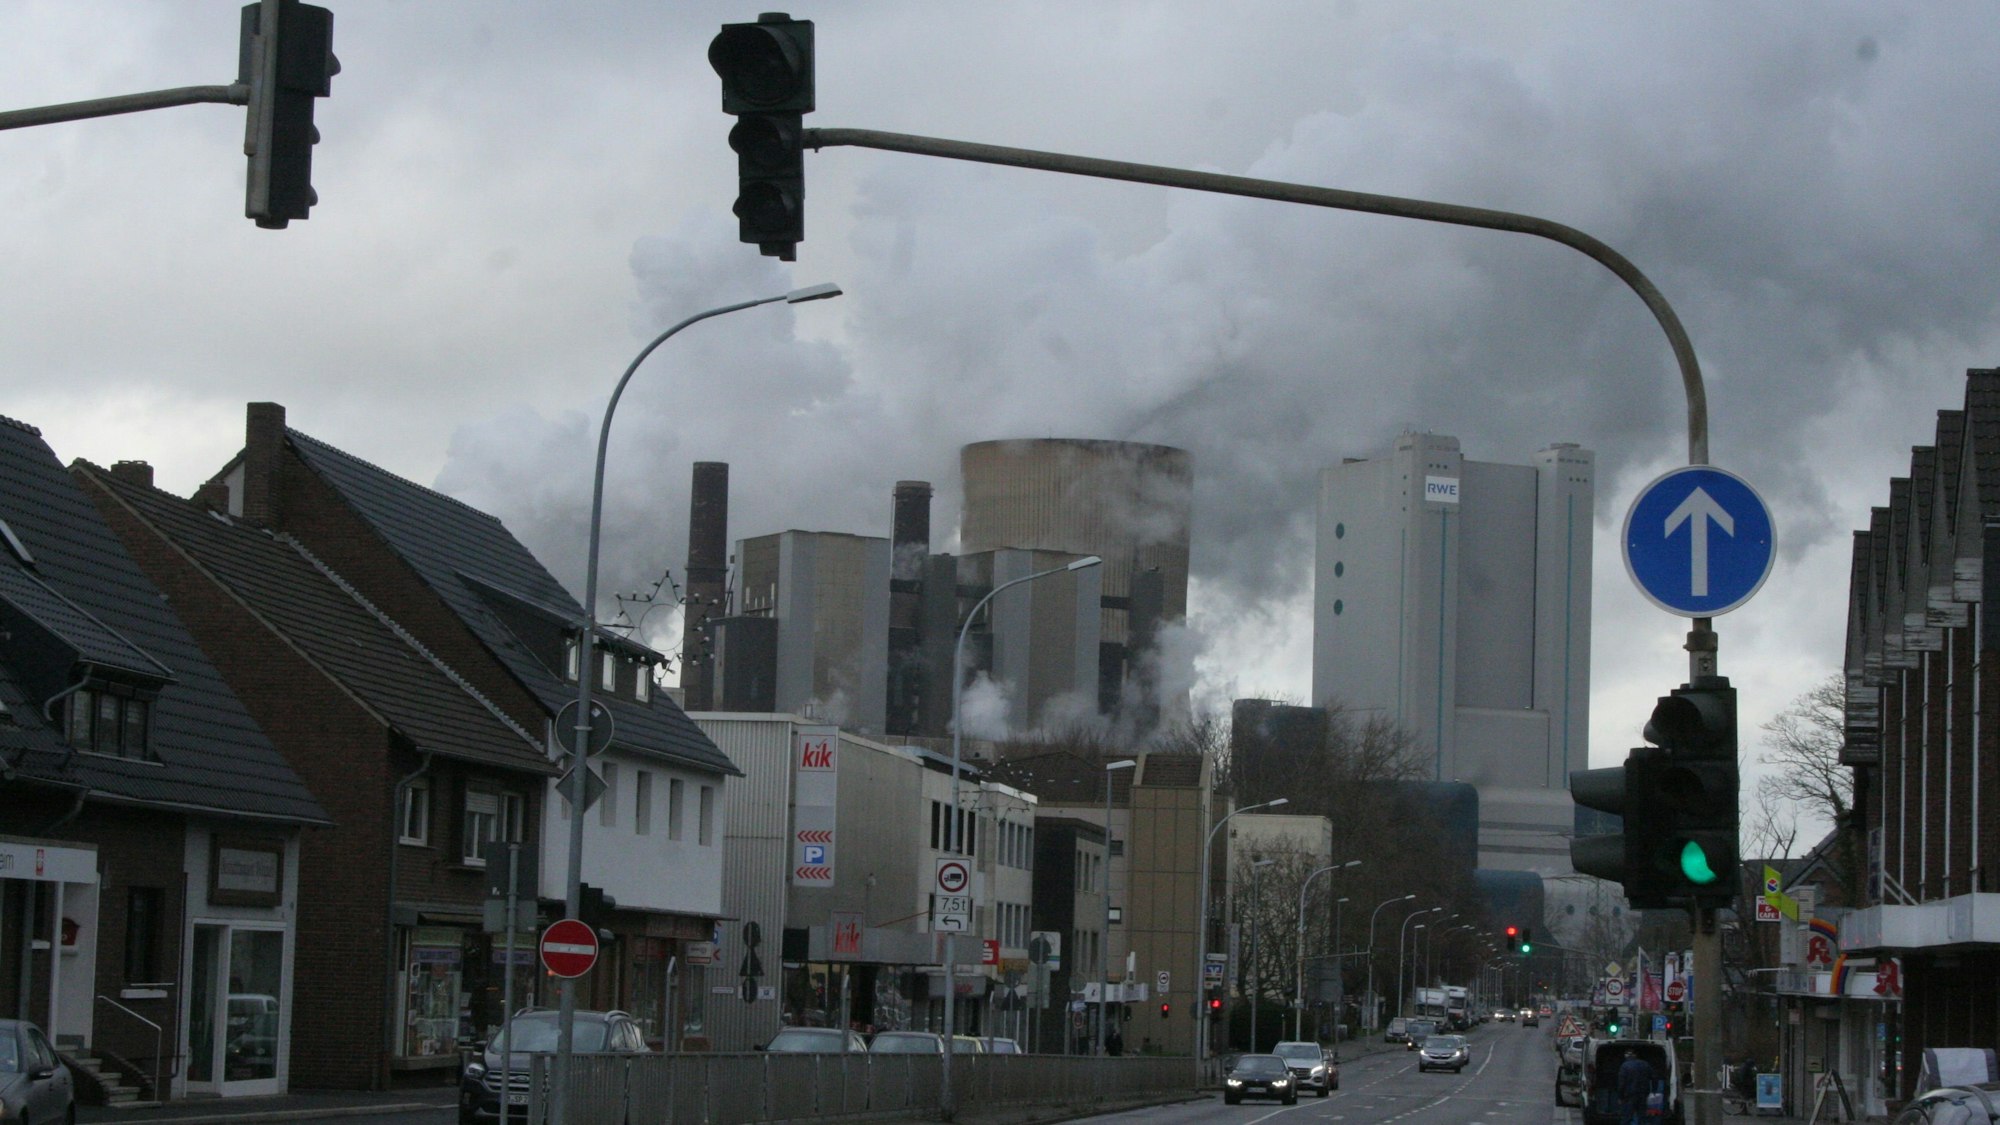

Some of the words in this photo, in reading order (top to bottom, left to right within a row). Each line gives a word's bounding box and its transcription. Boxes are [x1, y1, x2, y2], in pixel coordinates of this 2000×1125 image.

[1427, 482, 1457, 496] RWE
[941, 897, 960, 912] 7,5
[1668, 986, 1684, 996] STOP
